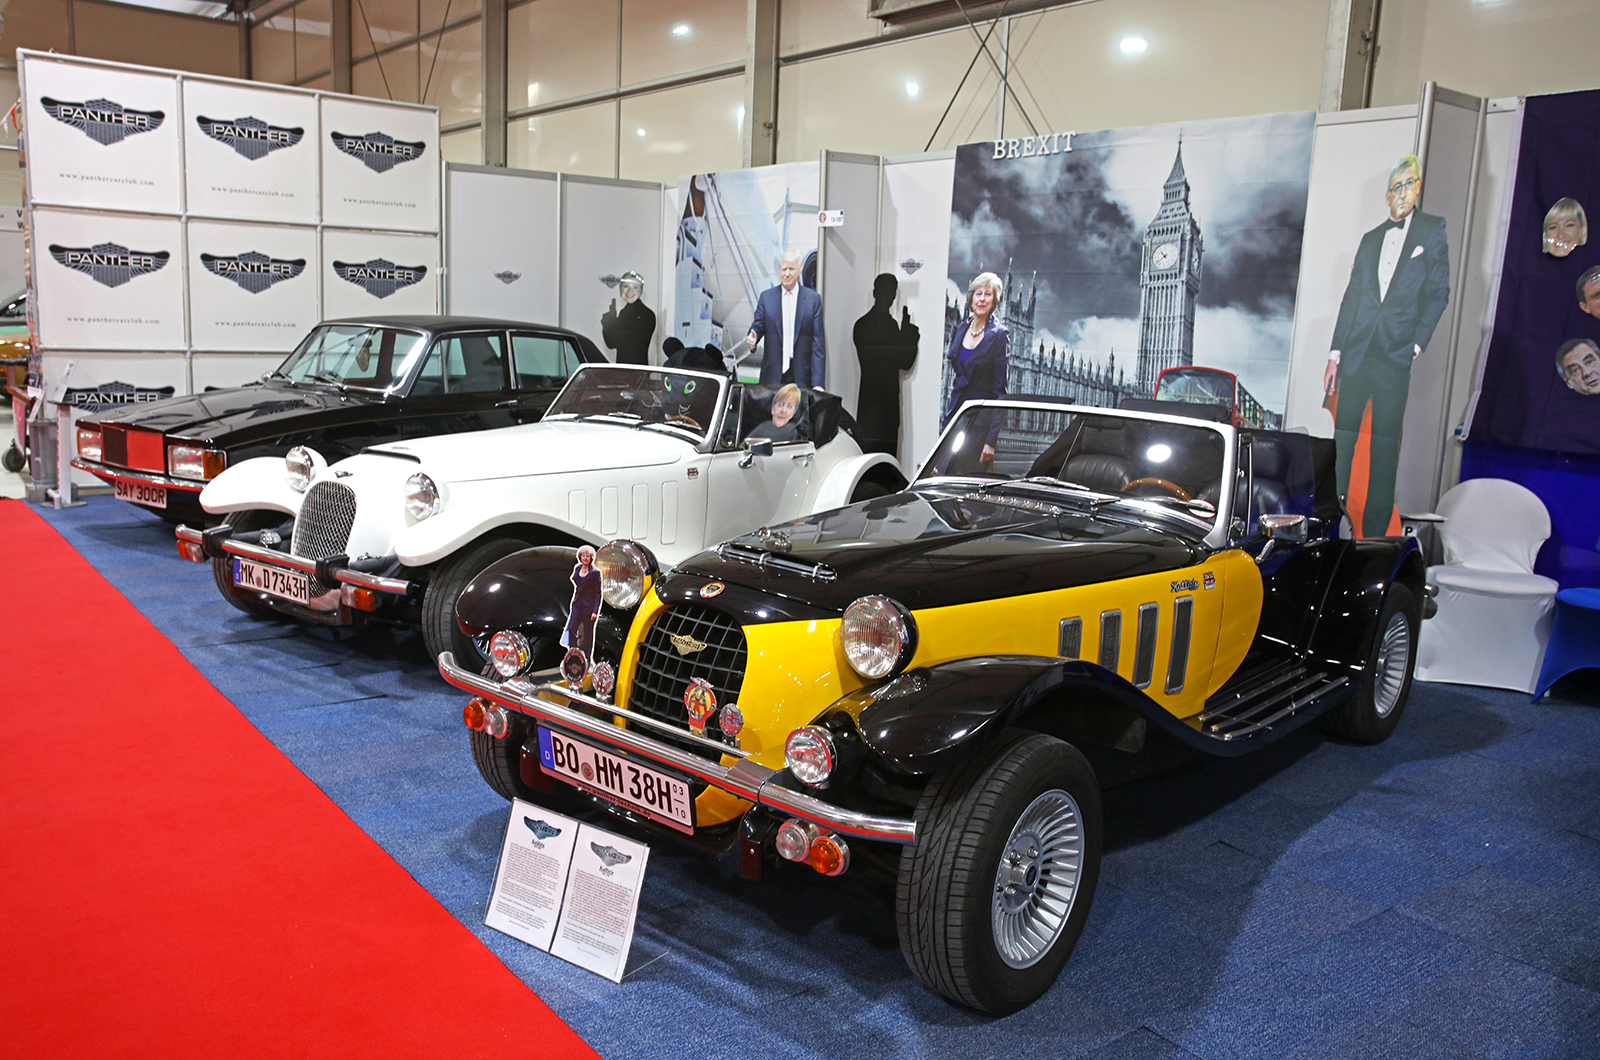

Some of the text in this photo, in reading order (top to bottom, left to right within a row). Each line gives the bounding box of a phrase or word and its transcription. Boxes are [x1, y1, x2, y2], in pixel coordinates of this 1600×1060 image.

[60, 106, 149, 127] PANTHER
[213, 124, 290, 142] PANTHER
[345, 139, 413, 156] PANTHER
[992, 130, 1077, 160] BREXIT
[59, 172, 156, 187] www.panthercarclub.com
[211, 186, 295, 198] www.panthercarclub.com
[343, 197, 417, 209] www.panthercarclub.com
[68, 253, 154, 267] PANTHER
[217, 261, 293, 274] PANTHER
[347, 268, 414, 280] PANTHER
[67, 317, 160, 325] www.panthercarclub.com
[214, 320, 297, 329] www.panthercarclub.com
[75, 393, 159, 404] PANTHER
[116, 481, 134, 498] SAY
[240, 563, 255, 586] MK
[544, 750, 551, 761] D
[552, 736, 673, 814] BO HM 38H
[672, 784, 684, 796] 03
[675, 807, 687, 820] 10
